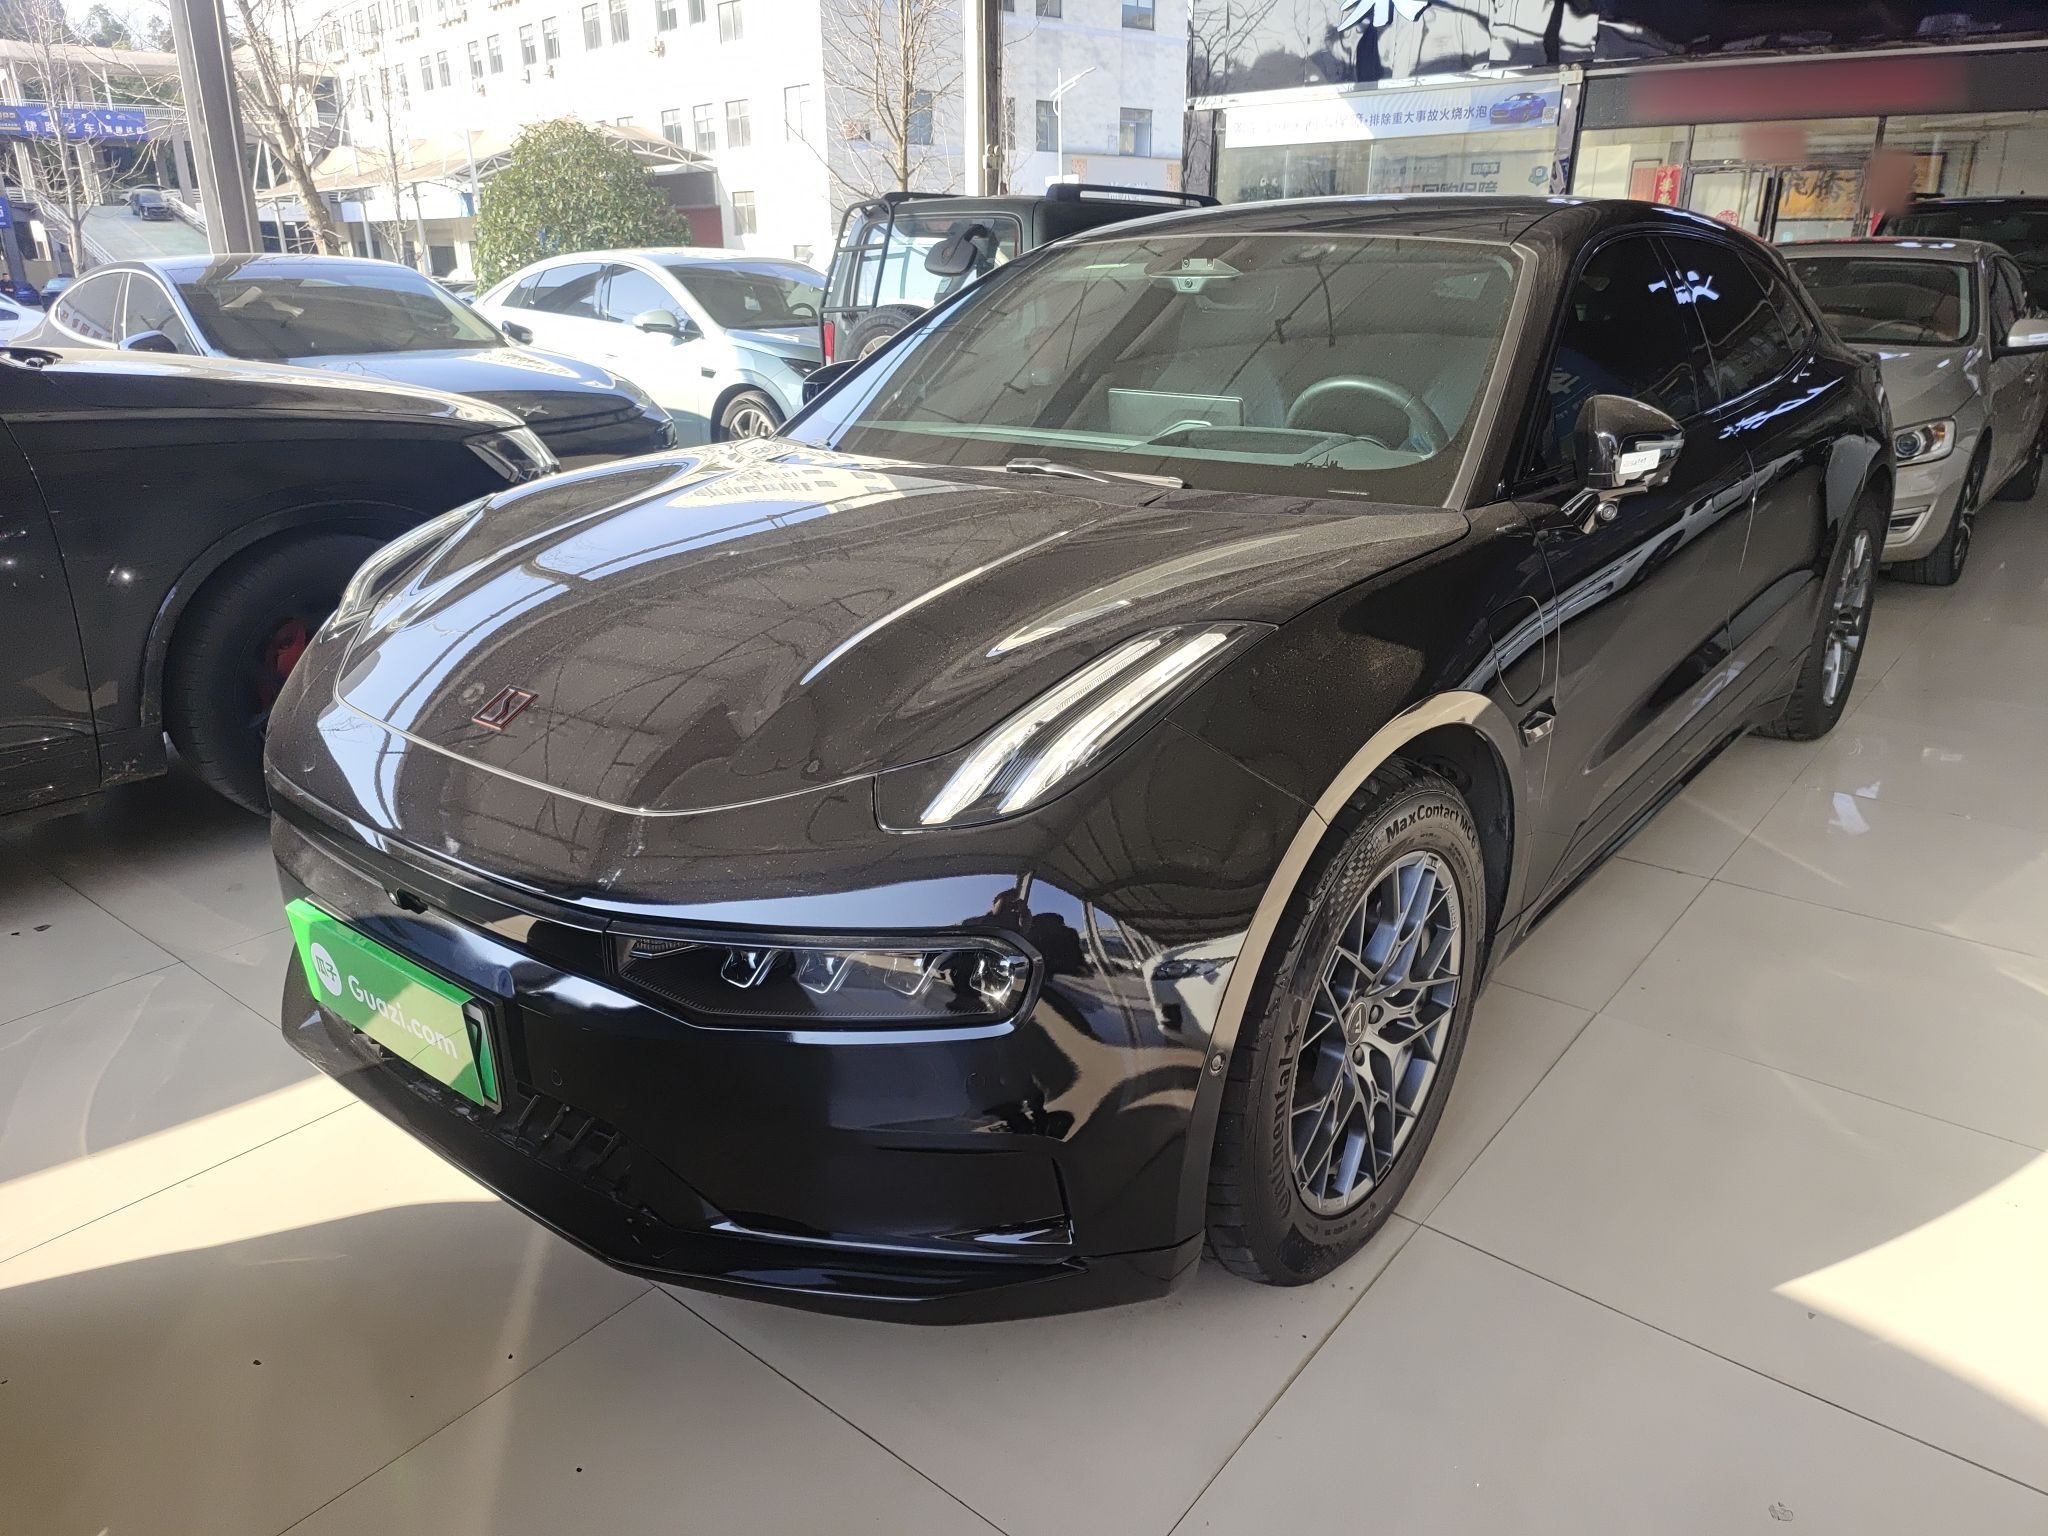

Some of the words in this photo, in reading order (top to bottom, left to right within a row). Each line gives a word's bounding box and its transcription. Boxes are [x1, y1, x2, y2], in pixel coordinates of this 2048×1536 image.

[1385, 803, 1460, 843] MaxContact
[1459, 814, 1476, 849] MC6
[315, 955, 338, 982] 瓜子
[348, 974, 459, 1059] Guazi.com
[1272, 1056, 1294, 1218] Continental
